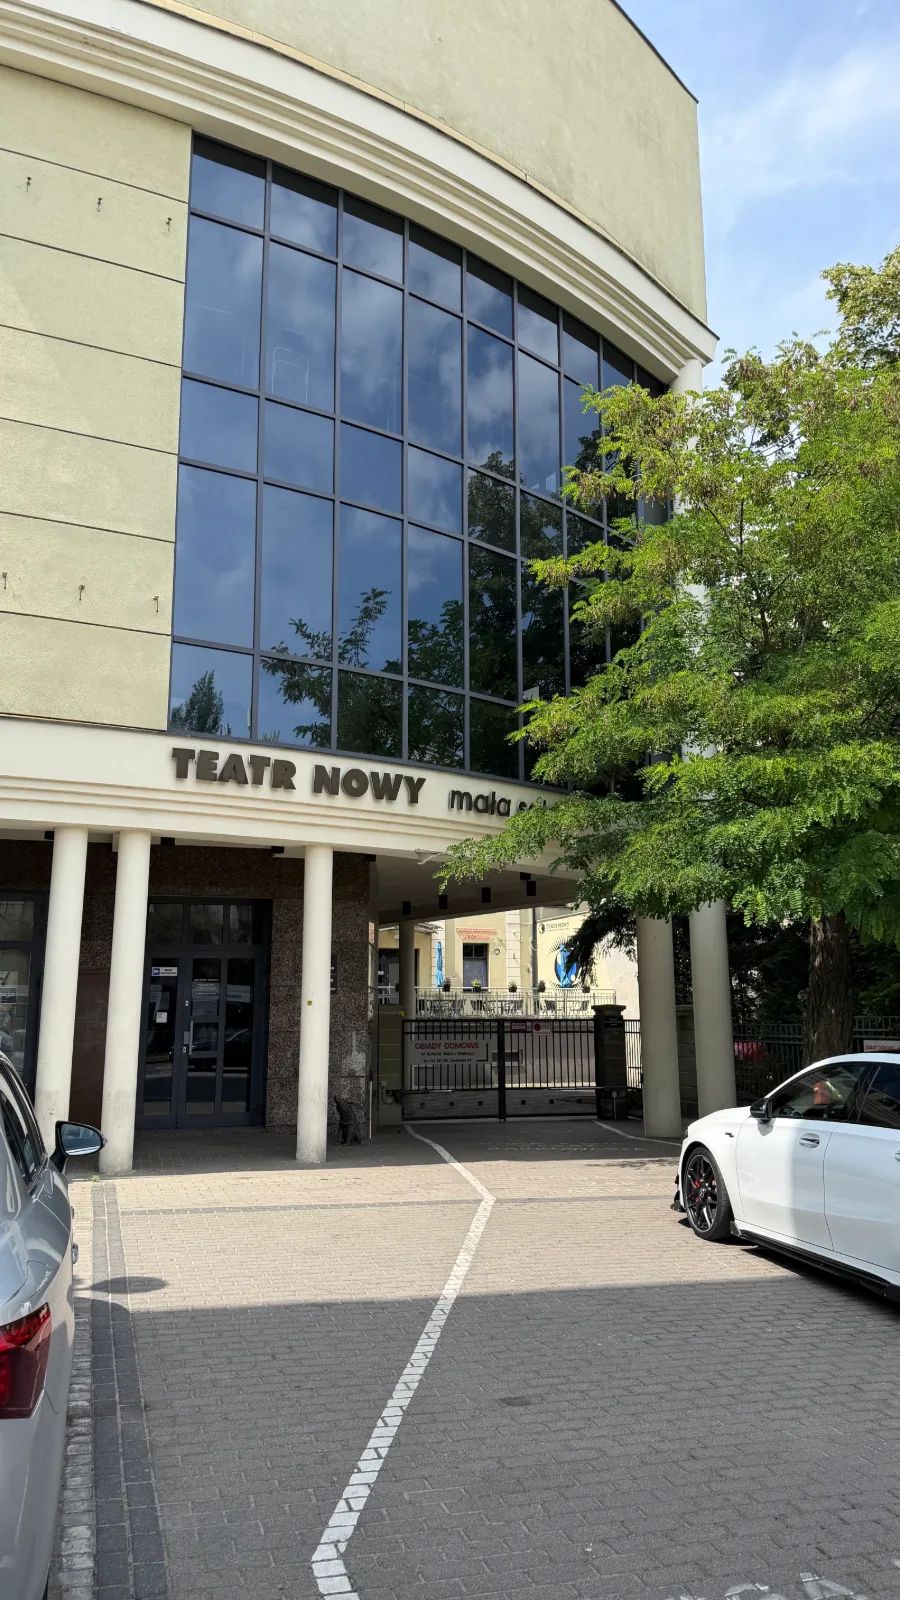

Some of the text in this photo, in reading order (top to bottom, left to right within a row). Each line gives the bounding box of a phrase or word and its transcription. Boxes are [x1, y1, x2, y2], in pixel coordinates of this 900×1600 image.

[172, 747, 296, 790] TEATR
[313, 764, 427, 804] NOWY
[414, 1041, 480, 1050] OBIADY DOMOWE
